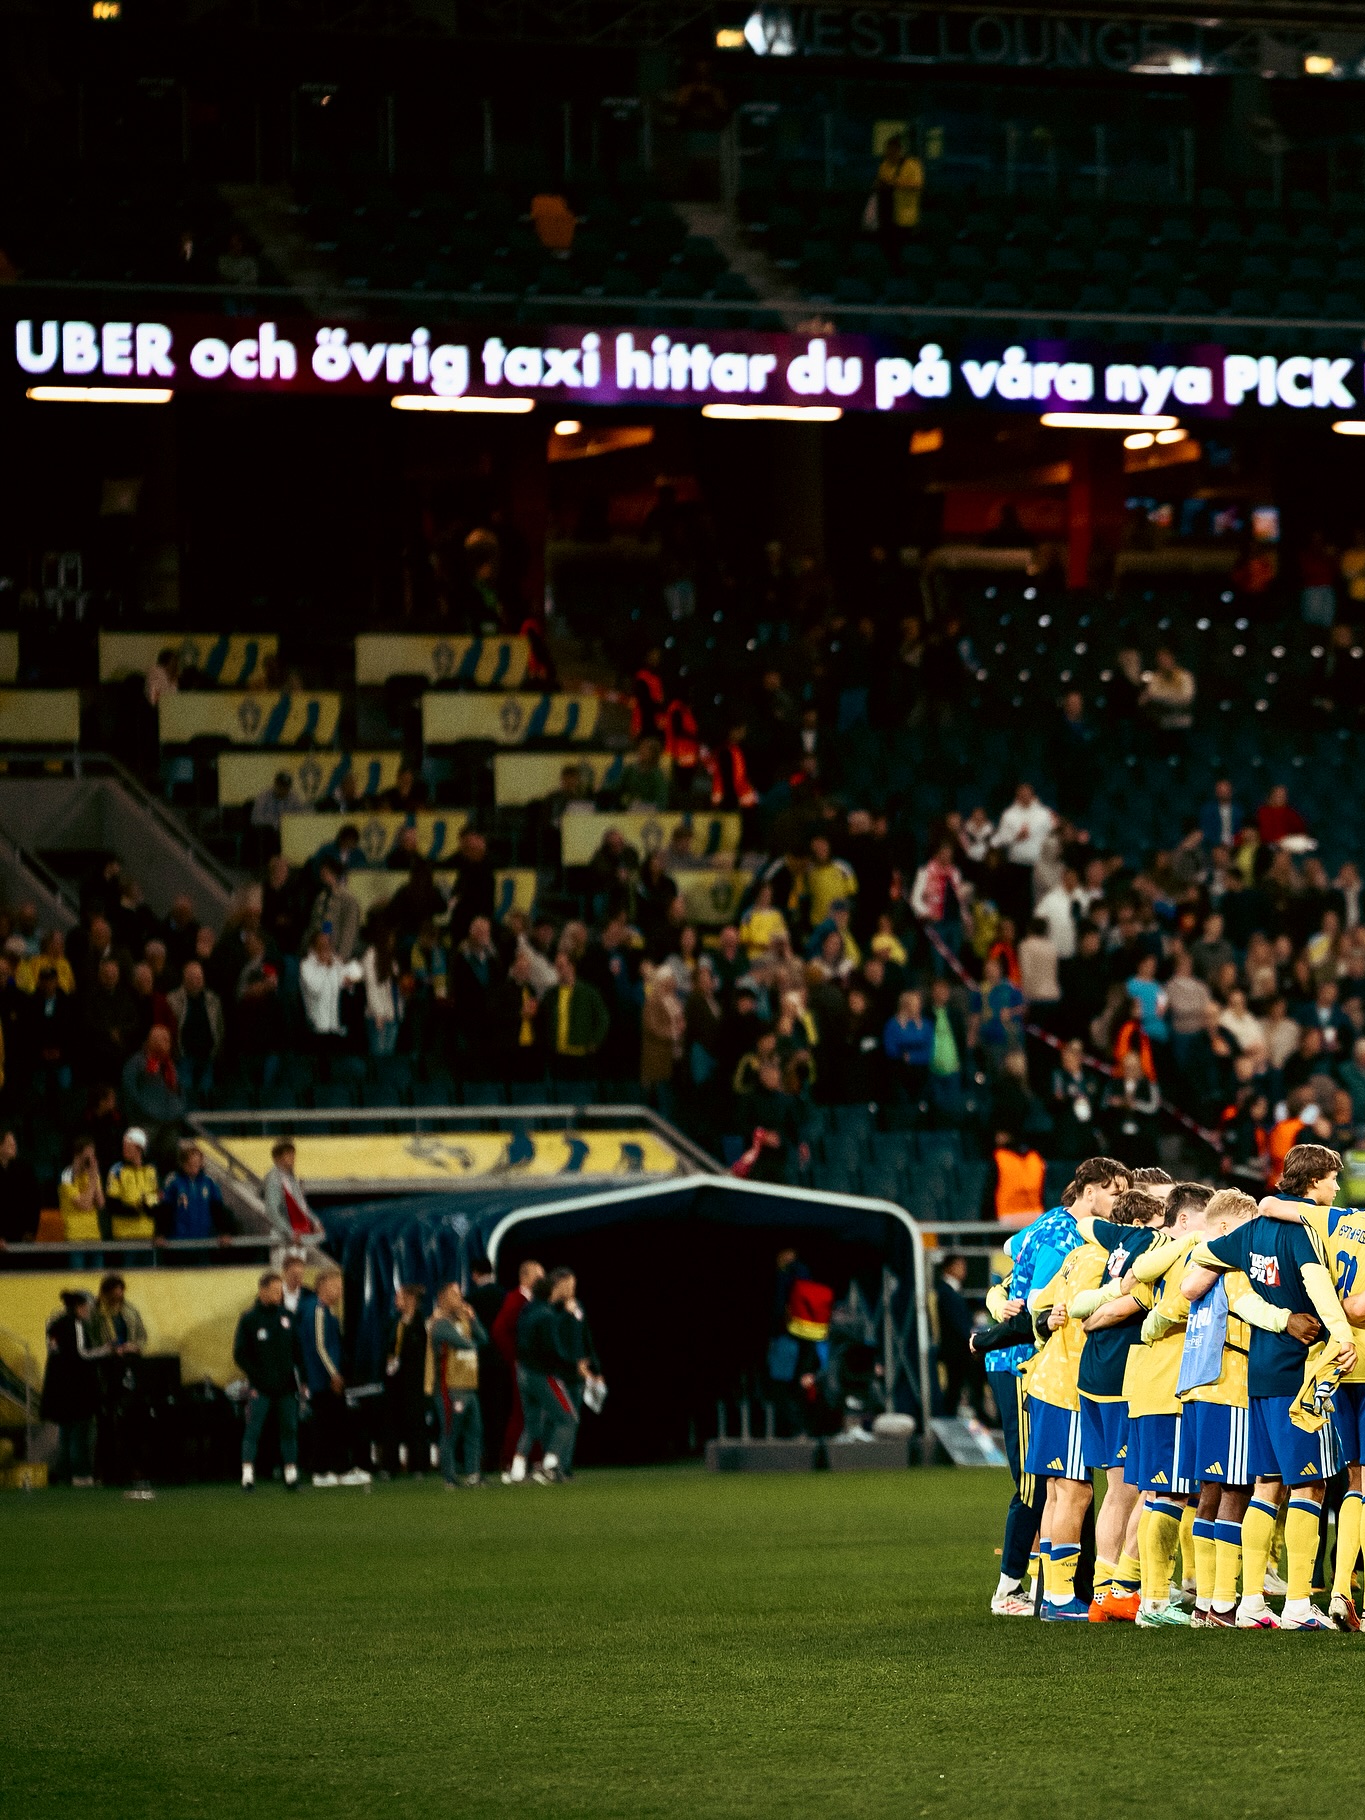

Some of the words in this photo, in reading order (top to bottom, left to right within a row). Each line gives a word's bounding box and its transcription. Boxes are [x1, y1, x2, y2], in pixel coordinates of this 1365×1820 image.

[16, 320, 176, 376] UBER
[190, 322, 297, 380] och
[312, 326, 472, 396] övrig
[482, 334, 601, 388] taxi
[615, 332, 777, 393] hittar
[786, 338, 862, 396] du
[875, 343, 951, 411] på
[961, 345, 1094, 402] våra
[1104, 363, 1212, 414] nya
[1224, 355, 1355, 408] PICK
